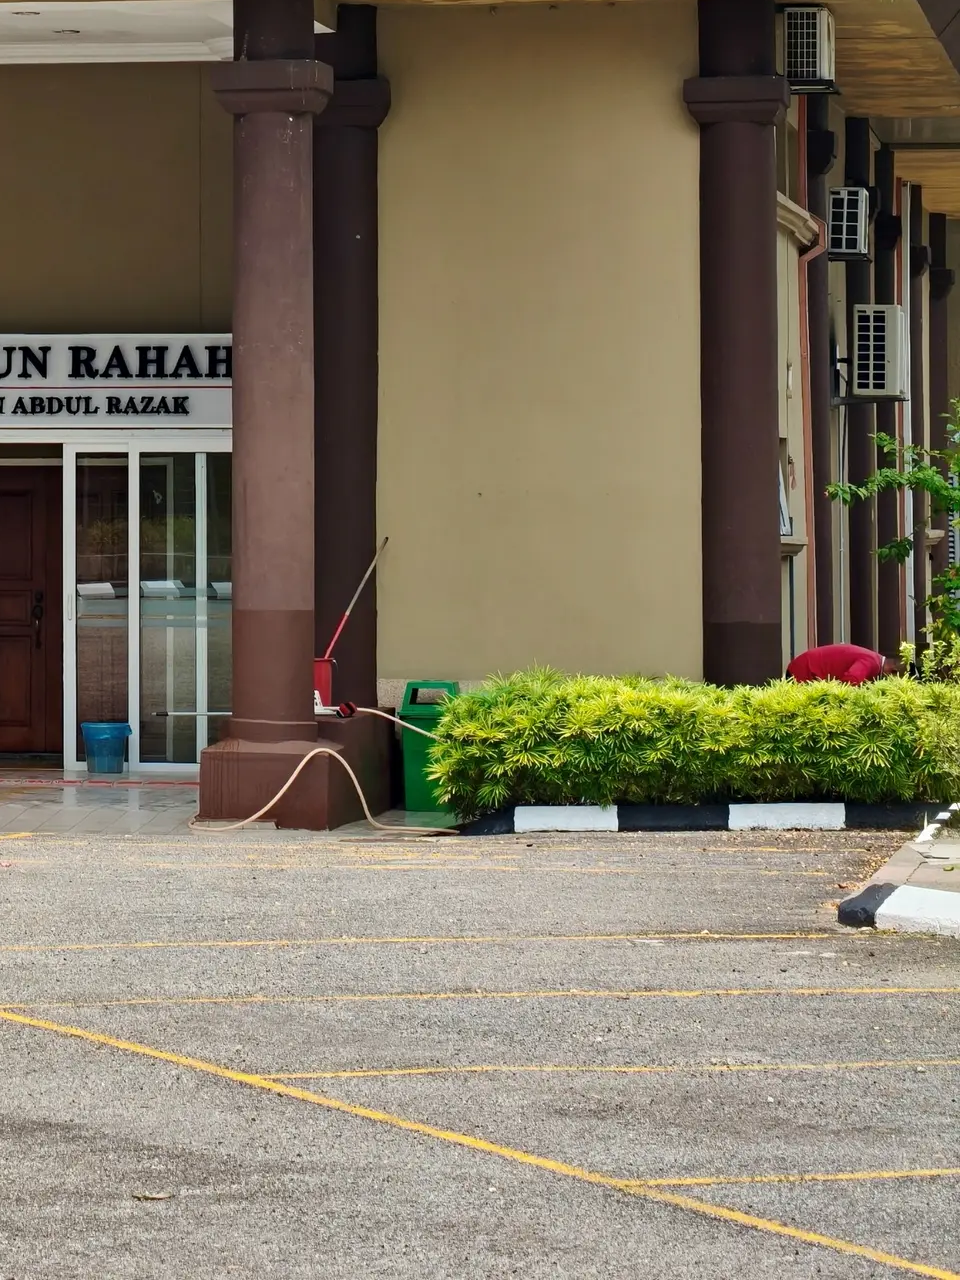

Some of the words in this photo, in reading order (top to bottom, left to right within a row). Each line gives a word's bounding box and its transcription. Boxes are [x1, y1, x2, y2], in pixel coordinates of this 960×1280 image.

[67, 345, 232, 379] RAHAH
[10, 396, 101, 416] ABDUL
[105, 396, 190, 416] RAZAK
